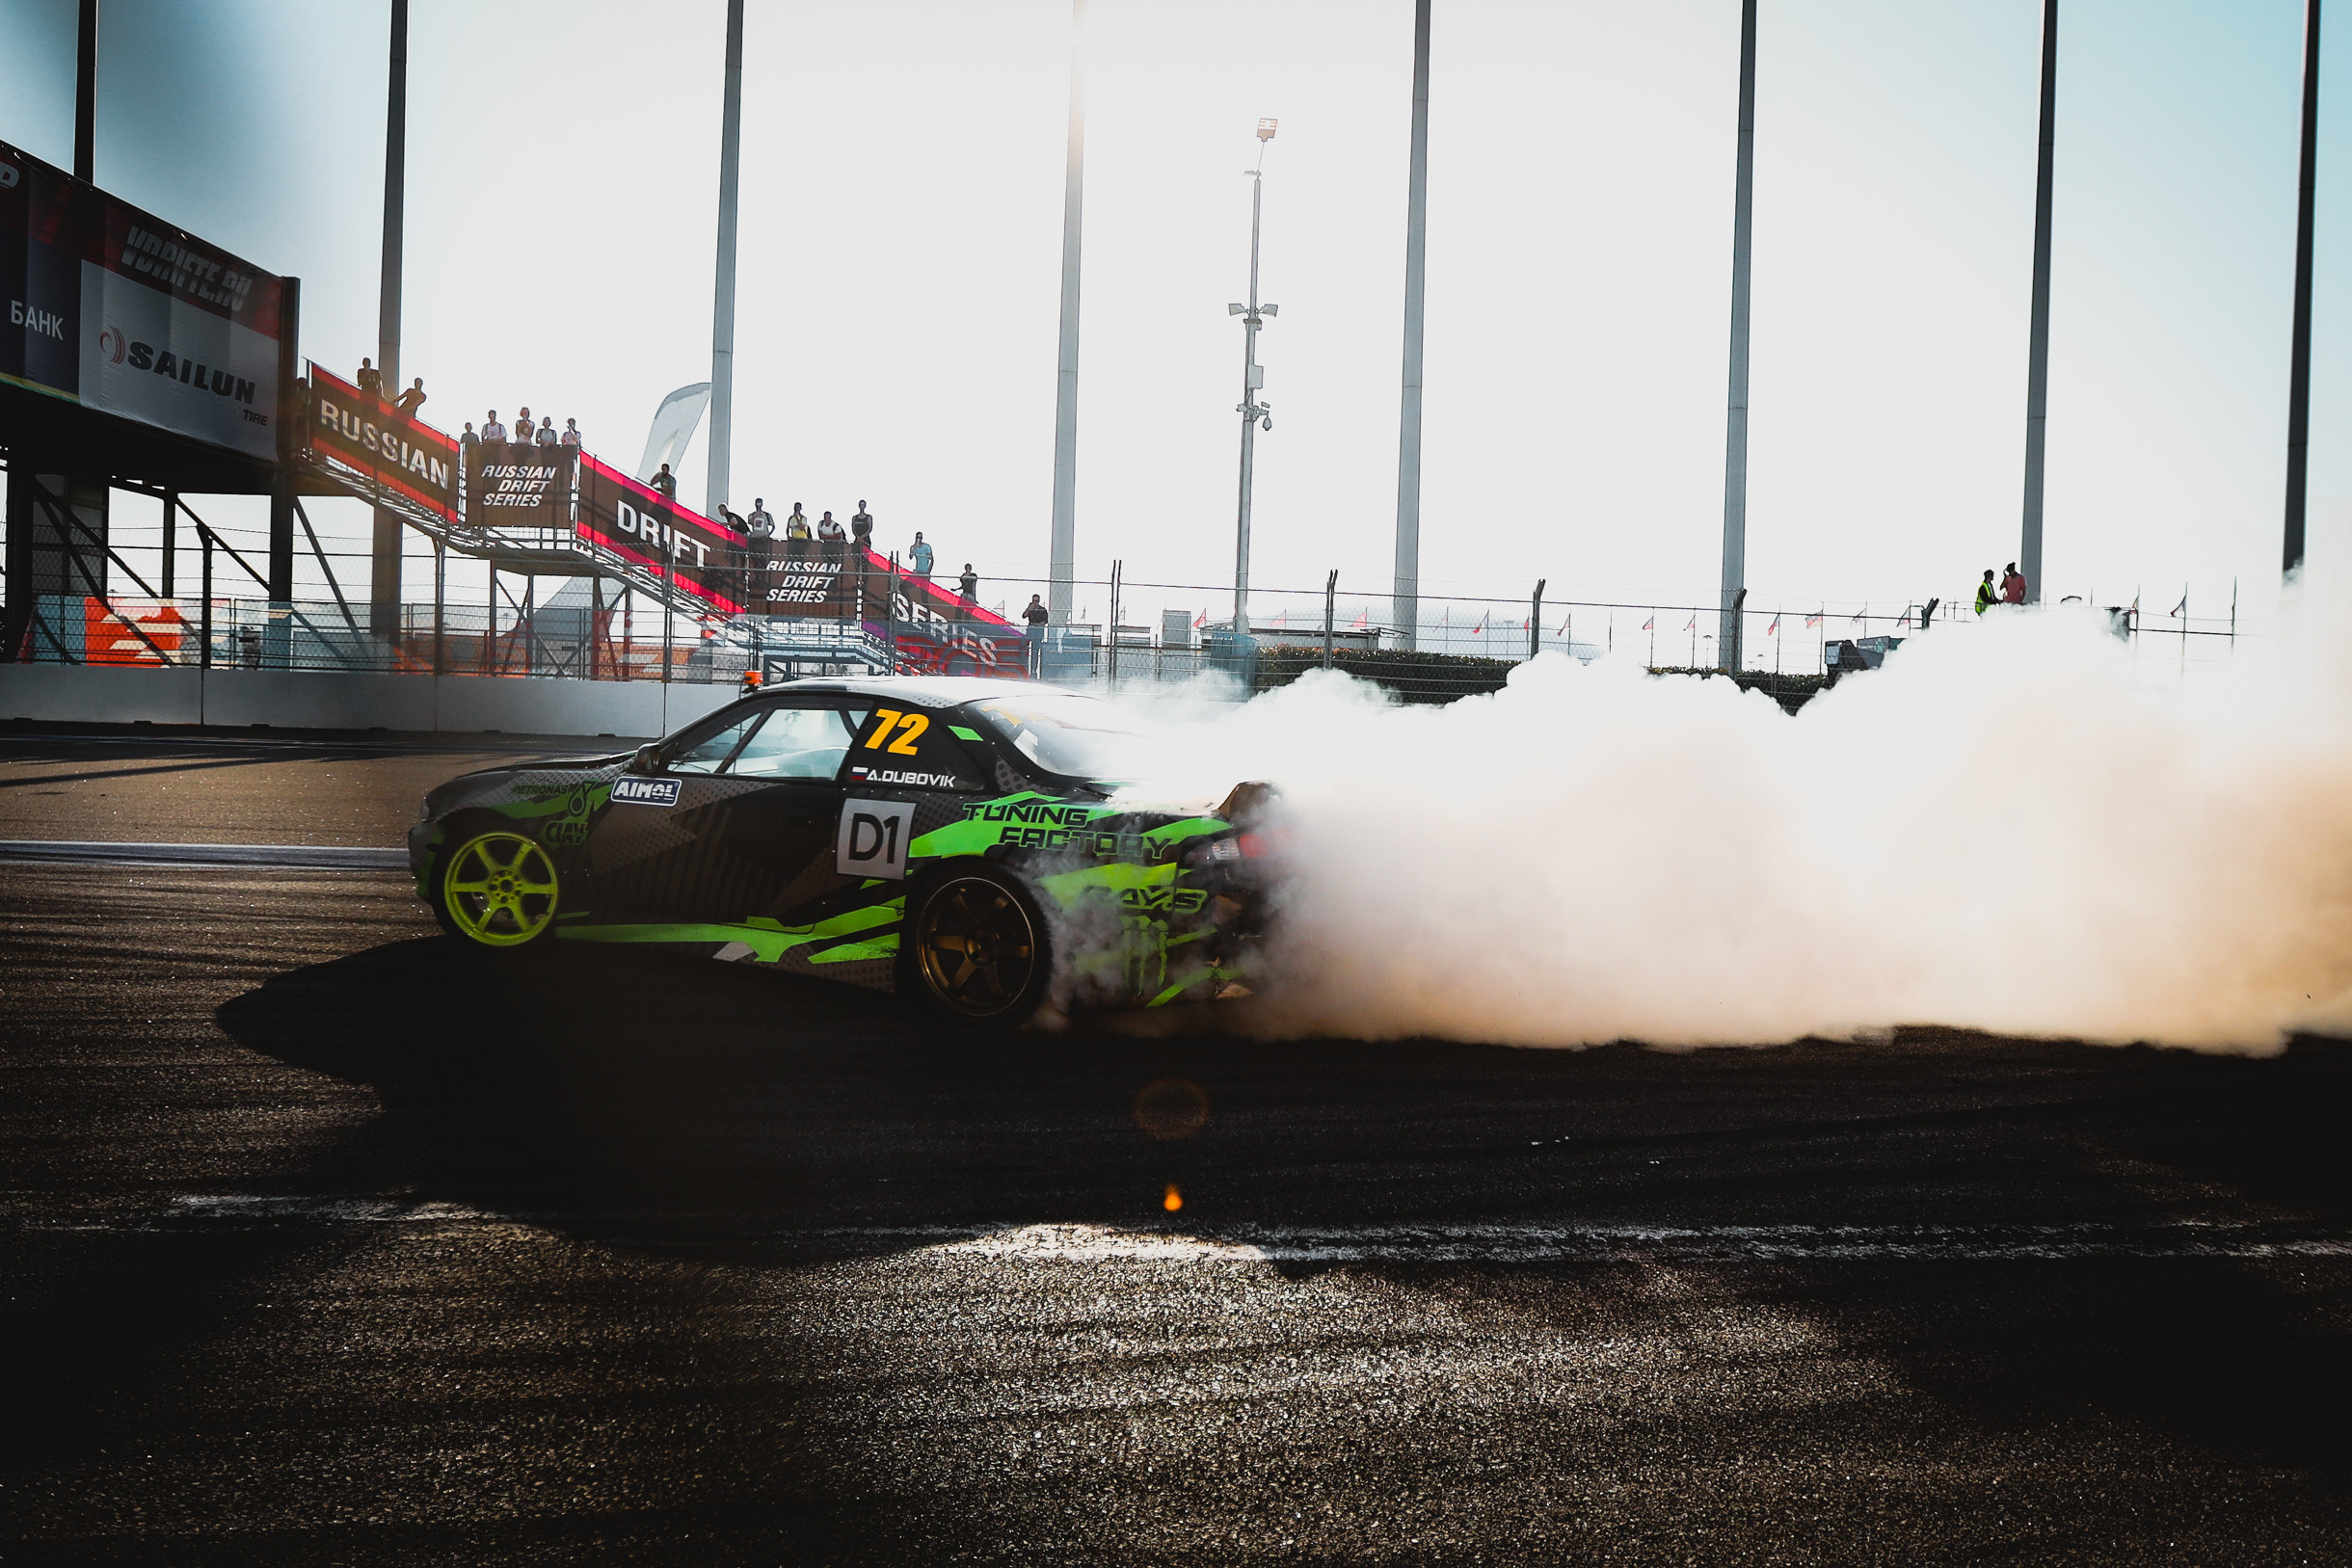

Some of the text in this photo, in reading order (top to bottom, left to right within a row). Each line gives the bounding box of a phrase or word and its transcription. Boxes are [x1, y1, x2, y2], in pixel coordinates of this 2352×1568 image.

[11, 299, 64, 340] БАНК
[127, 341, 256, 406] SAILUN
[243, 409, 268, 426] TIRE
[320, 398, 449, 491] RUSSIAN
[481, 465, 557, 479] RUSSIAN
[497, 479, 550, 492] DRIFT
[482, 492, 543, 507] SERIES
[617, 499, 711, 571] DRIFT
[765, 560, 842, 573] RUSSIAN
[782, 574, 835, 590] DRIFT
[765, 588, 828, 603] SERIES
[892, 592, 998, 667] SERIES
[864, 708, 930, 756] 72
[866, 769, 956, 788] A.DUBOVIK
[512, 784, 569, 796] PETRONAS
[613, 781, 675, 801] AIMOL
[964, 803, 1090, 827] TUNING
[848, 811, 900, 864] D1
[999, 826, 1173, 859] FACTORY
